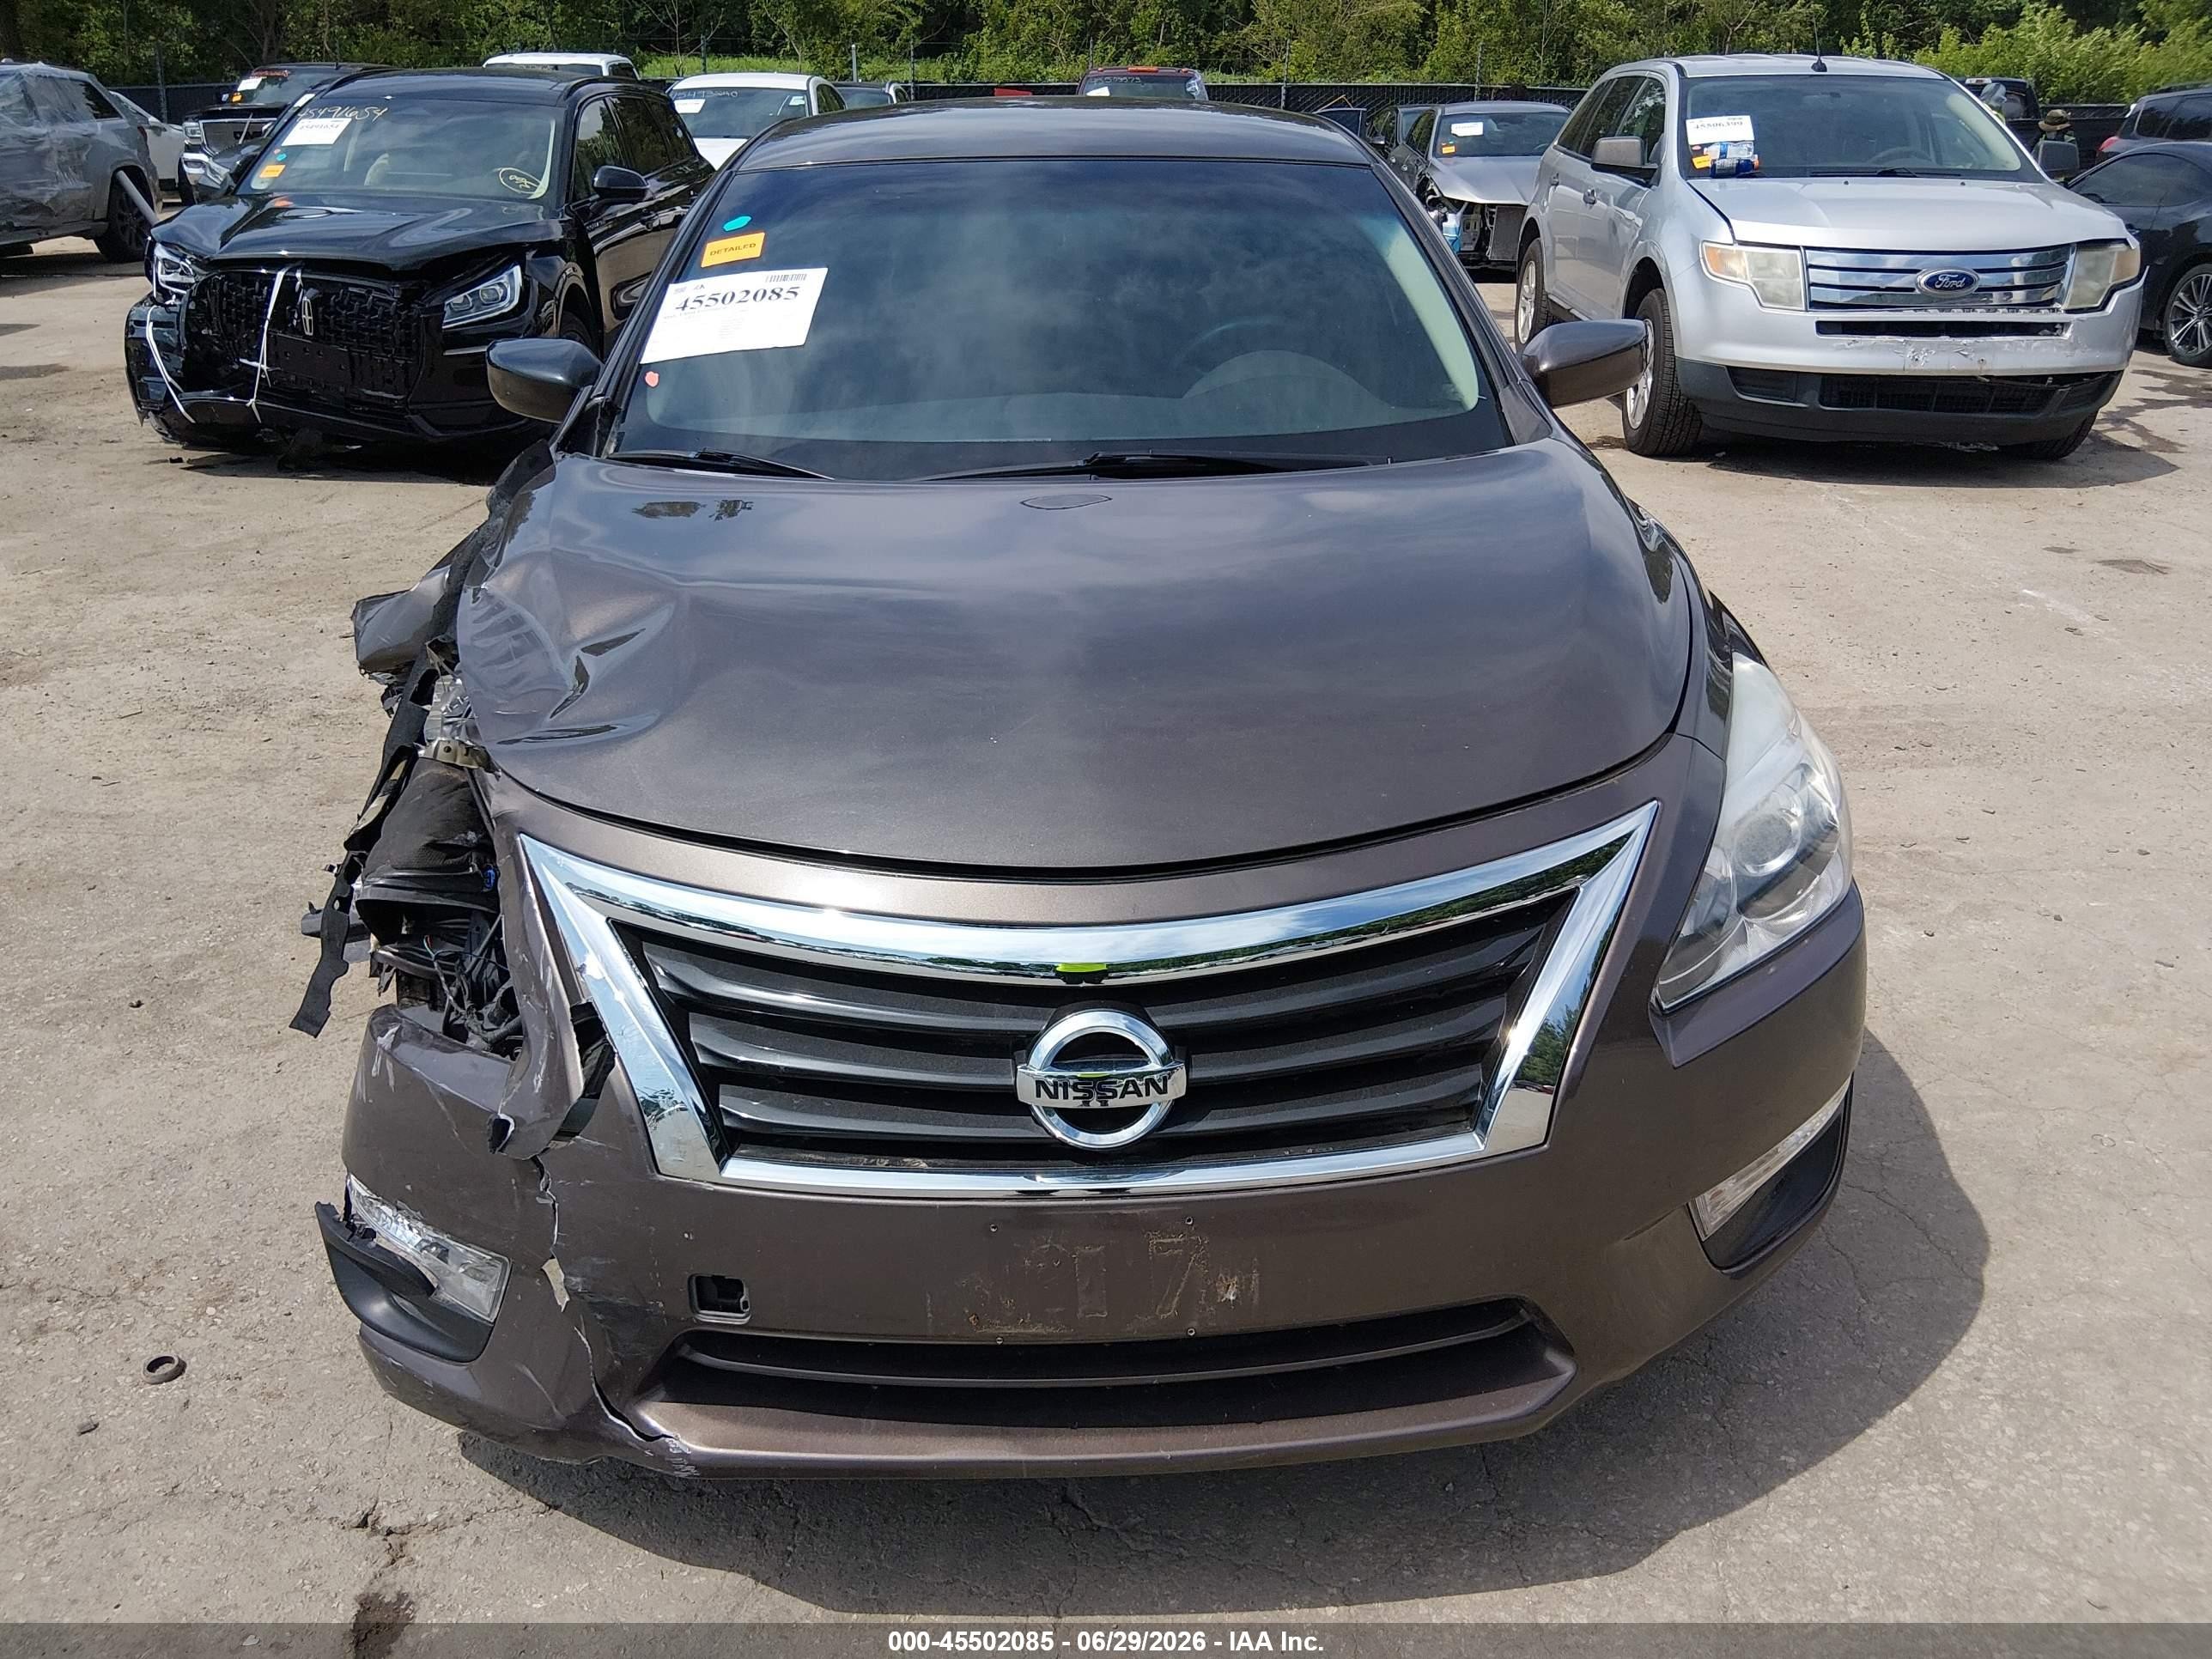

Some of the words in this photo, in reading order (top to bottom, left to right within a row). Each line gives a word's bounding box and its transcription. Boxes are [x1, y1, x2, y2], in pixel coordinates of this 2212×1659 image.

[709, 243, 757, 256] DETAILED
[1935, 274, 1966, 289] Ford
[675, 286, 802, 312] 45502085
[1035, 1075, 1170, 1101] NISSAN
